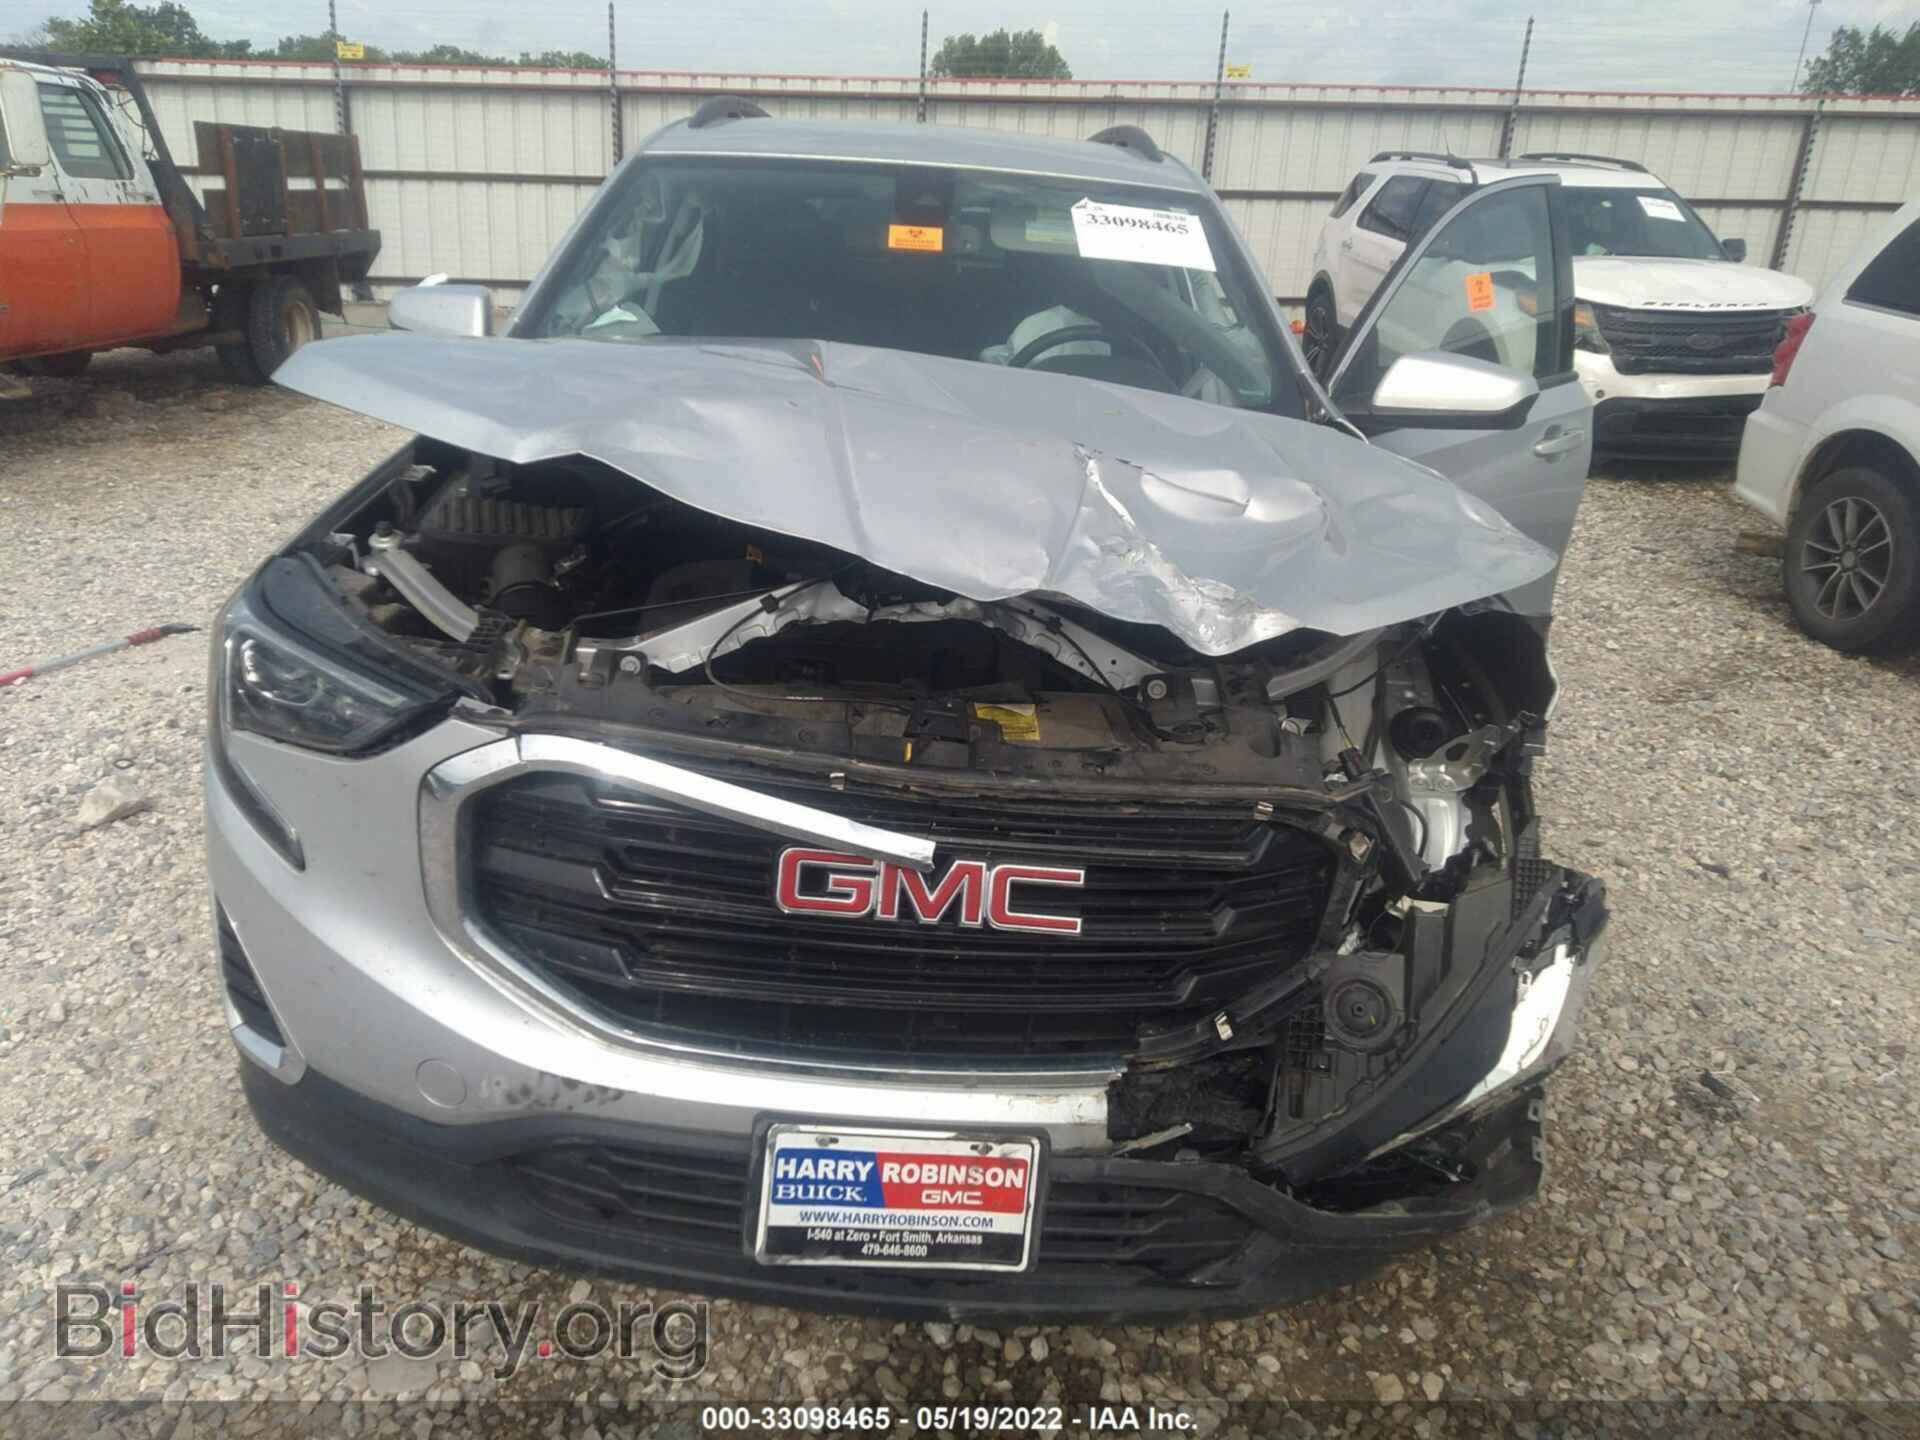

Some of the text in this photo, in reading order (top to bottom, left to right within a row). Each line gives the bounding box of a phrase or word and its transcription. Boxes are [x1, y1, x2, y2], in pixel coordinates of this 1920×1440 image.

[1086, 213, 1190, 235] 33098465
[776, 847, 1086, 934] GMC
[776, 1158, 1025, 1188] HARRY ROBINSON
[921, 1190, 984, 1205] GMC
[800, 1211, 994, 1229] WWW.HARRYROBINSON.COM
[834, 1231, 846, 1242] at
[847, 1230, 871, 1243] Zero
[879, 1232, 900, 1244] Fort
[902, 1233, 935, 1246] Smith,
[936, 1234, 983, 1246] Arkansas
